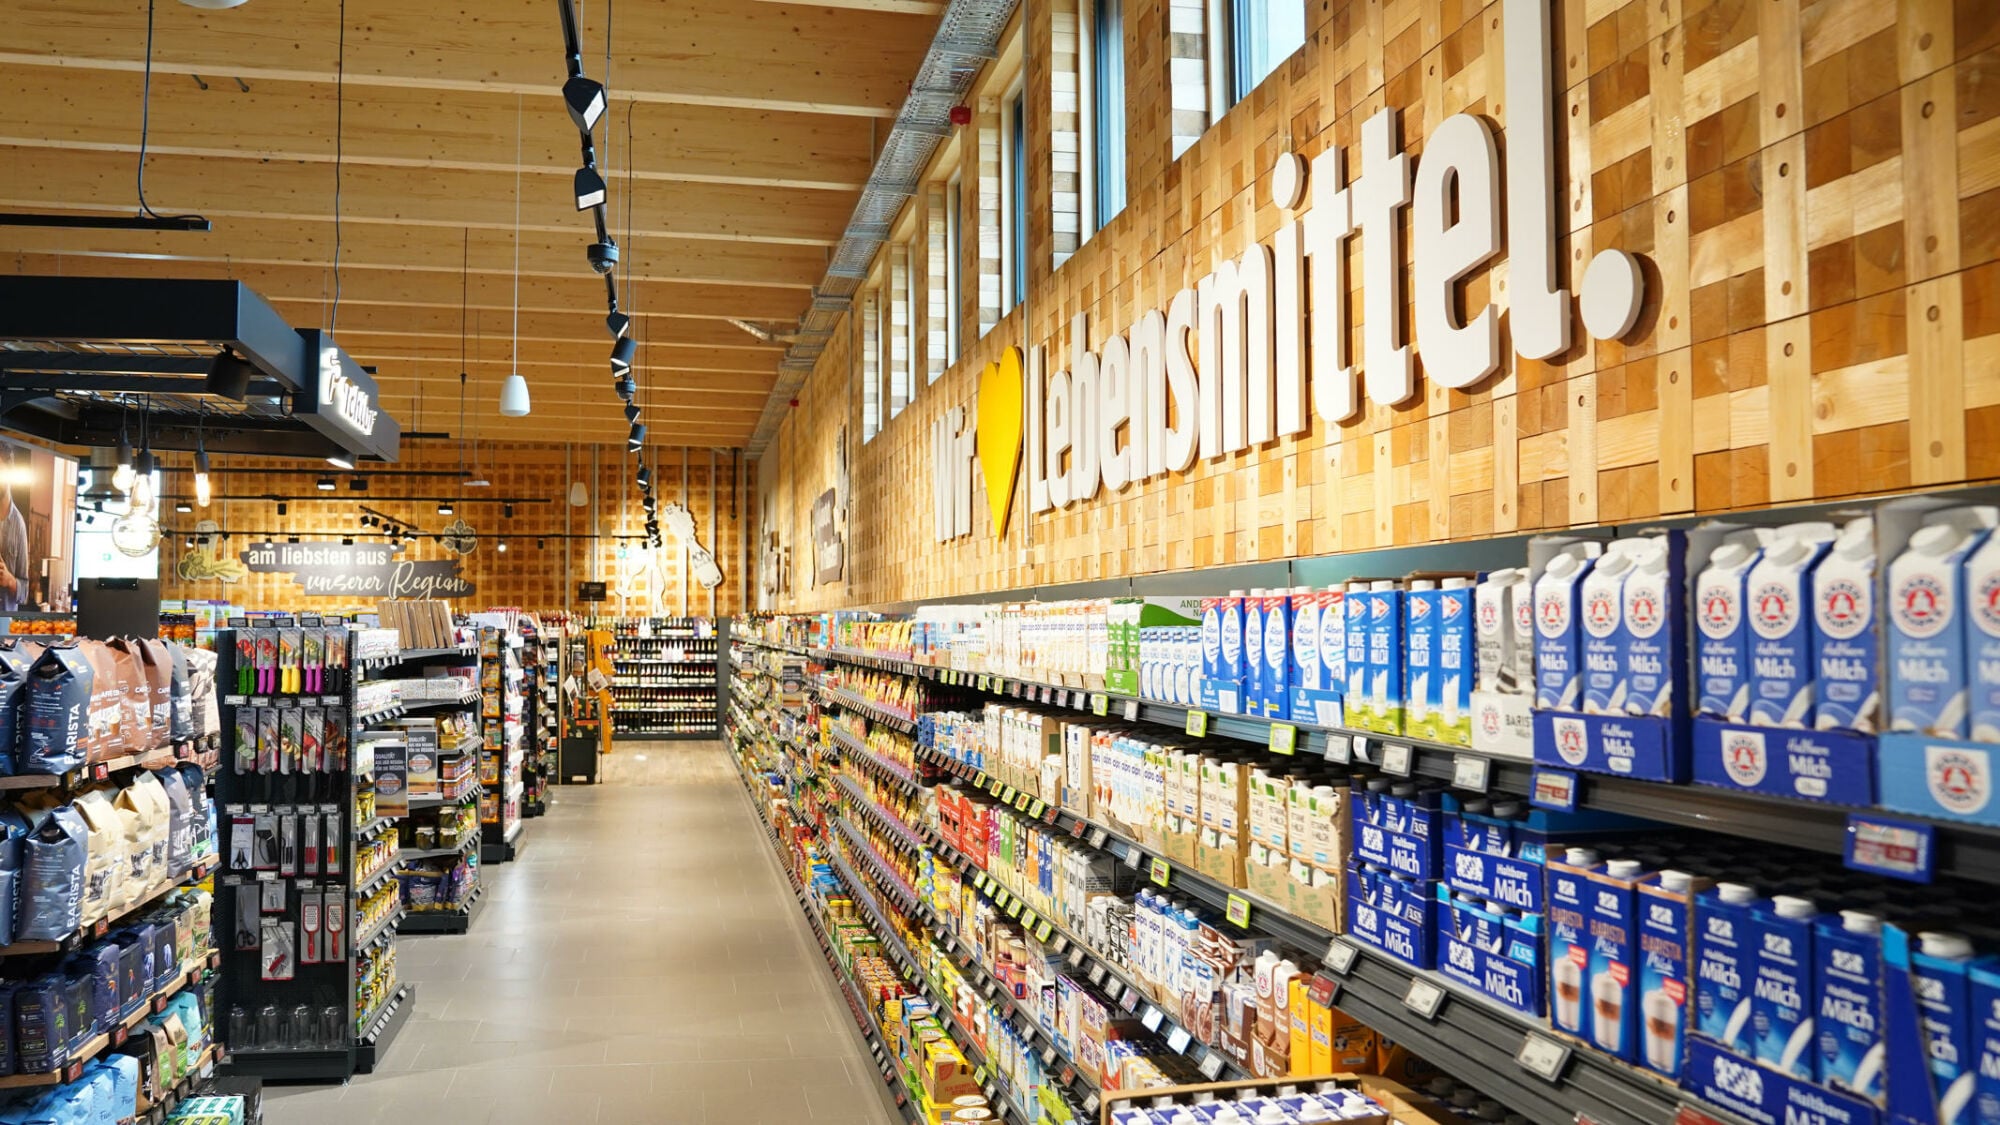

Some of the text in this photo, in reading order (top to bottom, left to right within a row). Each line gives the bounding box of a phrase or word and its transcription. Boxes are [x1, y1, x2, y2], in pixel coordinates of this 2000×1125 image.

[932, 405, 975, 542] Wir
[249, 546, 387, 565] am liebsten aus
[306, 560, 468, 600] unserer Region
[1540, 654, 1568, 671] Milch
[1587, 654, 1618, 671] Milch
[1629, 655, 1662, 673] Milch
[1701, 657, 1737, 676] Milch
[1754, 658, 1796, 678] Milch
[1821, 659, 1867, 681] Milch
[64, 703, 81, 764] BARISTA
[1603, 734, 1635, 759] Milch
[1789, 755, 1832, 778] Milch
[1391, 848, 1420, 875] Milch
[66, 863, 81, 928] BARISTA
[1494, 877, 1533, 908] Milch
[1384, 929, 1414, 960] Milch
[1485, 969, 1523, 1006] Milch
[1699, 959, 1742, 989] Milch
[1754, 977, 1802, 1010] Milch
[1821, 996, 1875, 1032] Milch
